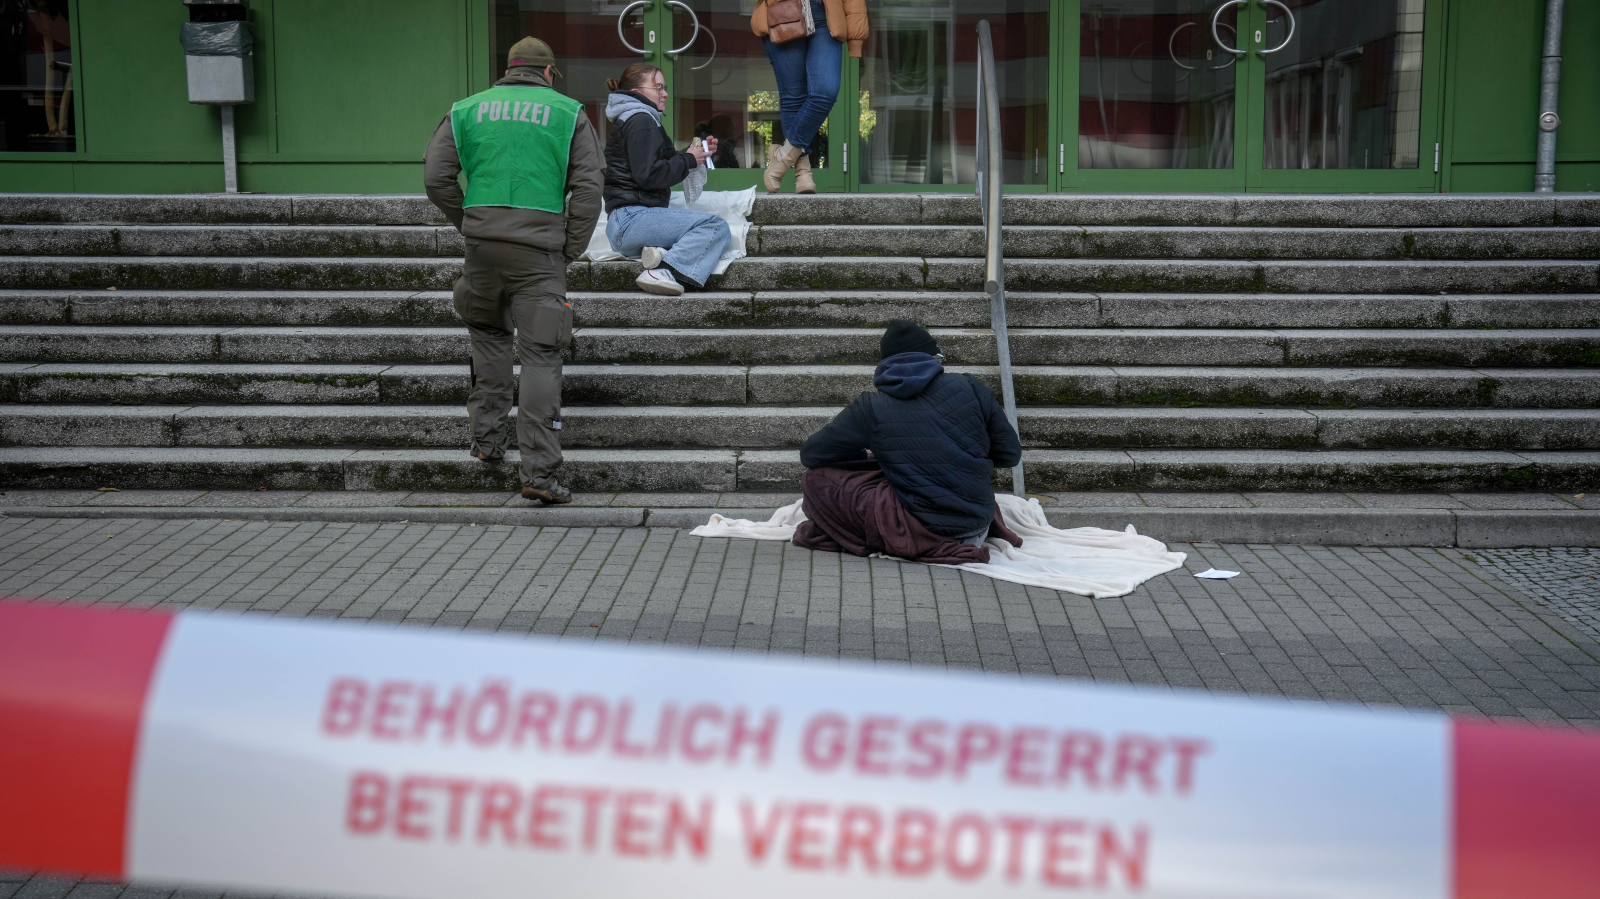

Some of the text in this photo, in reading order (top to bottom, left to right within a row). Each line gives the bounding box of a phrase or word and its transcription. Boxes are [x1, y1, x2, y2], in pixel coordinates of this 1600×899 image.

[477, 100, 551, 126] POLIZEI
[322, 676, 1212, 795] BEHÖRDLICH GESPERRT
[345, 771, 1150, 892] BETRETEN VERBOTEN
